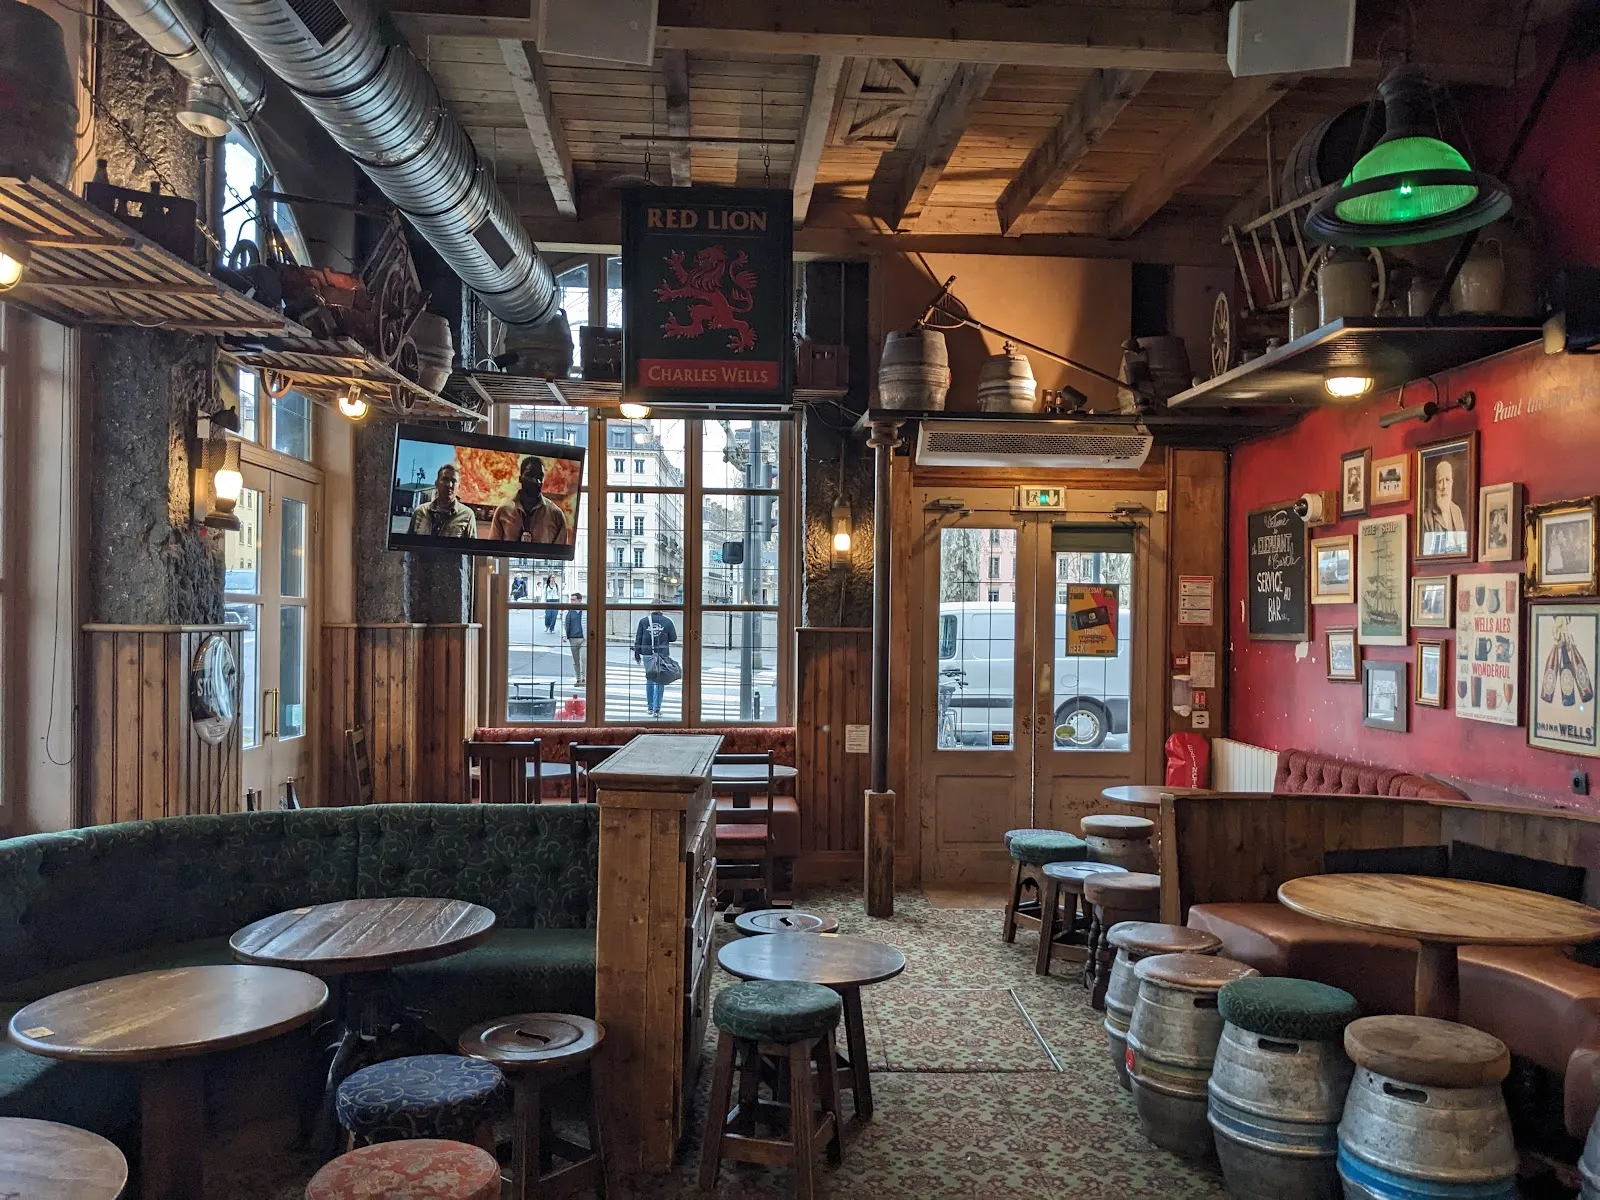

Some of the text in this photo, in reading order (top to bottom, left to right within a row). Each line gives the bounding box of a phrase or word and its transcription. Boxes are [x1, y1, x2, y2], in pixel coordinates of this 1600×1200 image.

[646, 207, 768, 232] RED LION
[1493, 398, 1523, 423] Paint
[1361, 521, 1398, 536] THE SHIP
[1256, 570, 1292, 601] SERVICE AU
[1268, 596, 1282, 622] BAR
[1474, 616, 1511, 634] WELLS ALES
[1472, 662, 1511, 679] WONDERFUL
